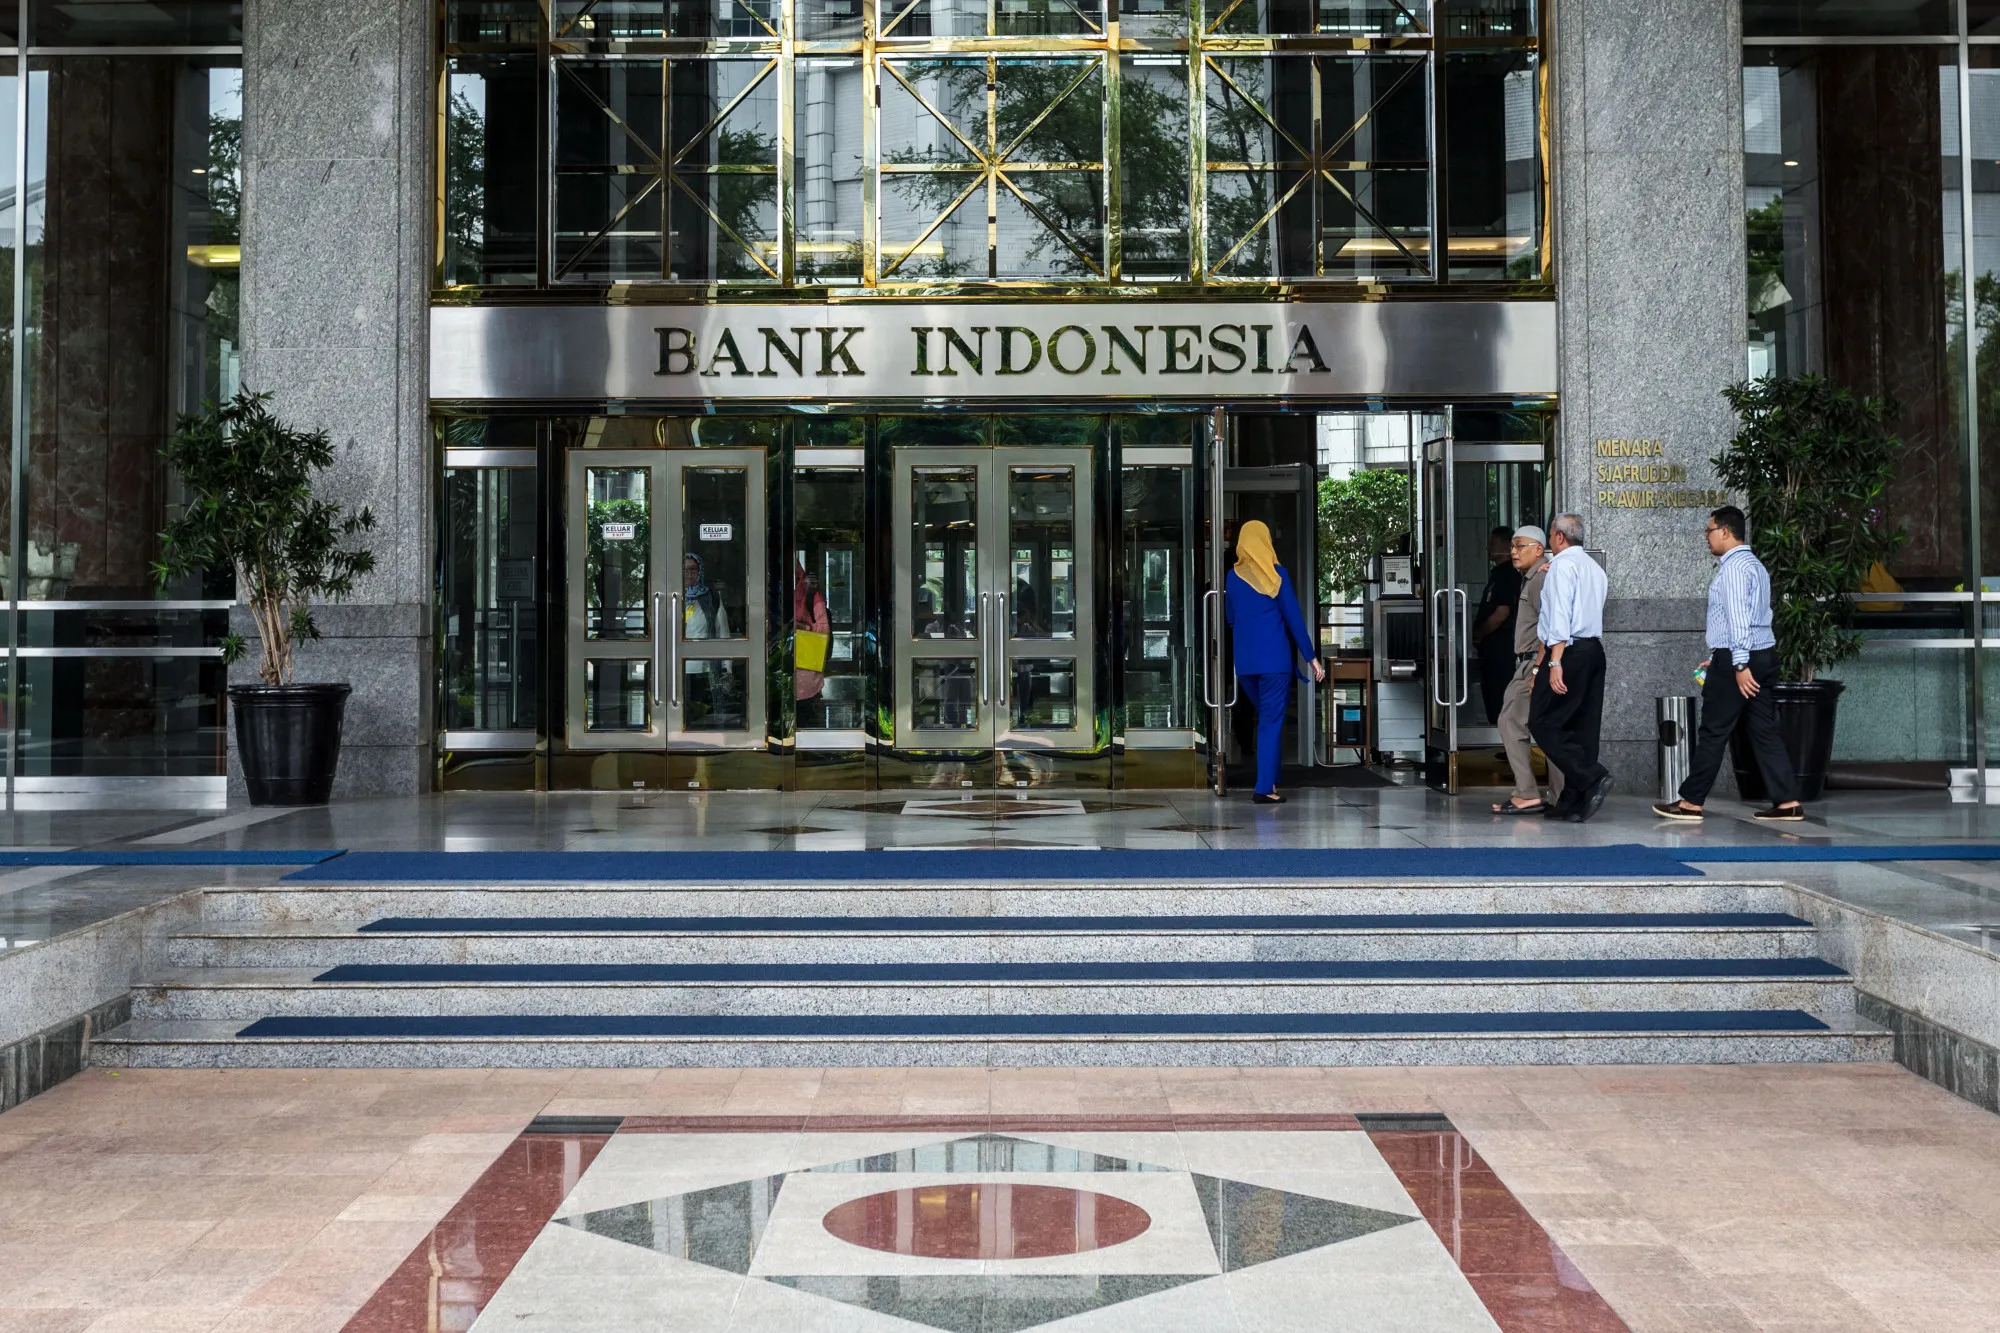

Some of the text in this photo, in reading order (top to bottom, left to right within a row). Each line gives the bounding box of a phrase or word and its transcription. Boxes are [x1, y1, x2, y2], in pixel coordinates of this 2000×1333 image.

[654, 324, 1332, 377] BANK INDONESIA
[1597, 439, 1663, 457] MENARA
[1597, 464, 1686, 483] SJAFRUDDIN
[1598, 489, 1727, 508] PRAWIRANEGARA
